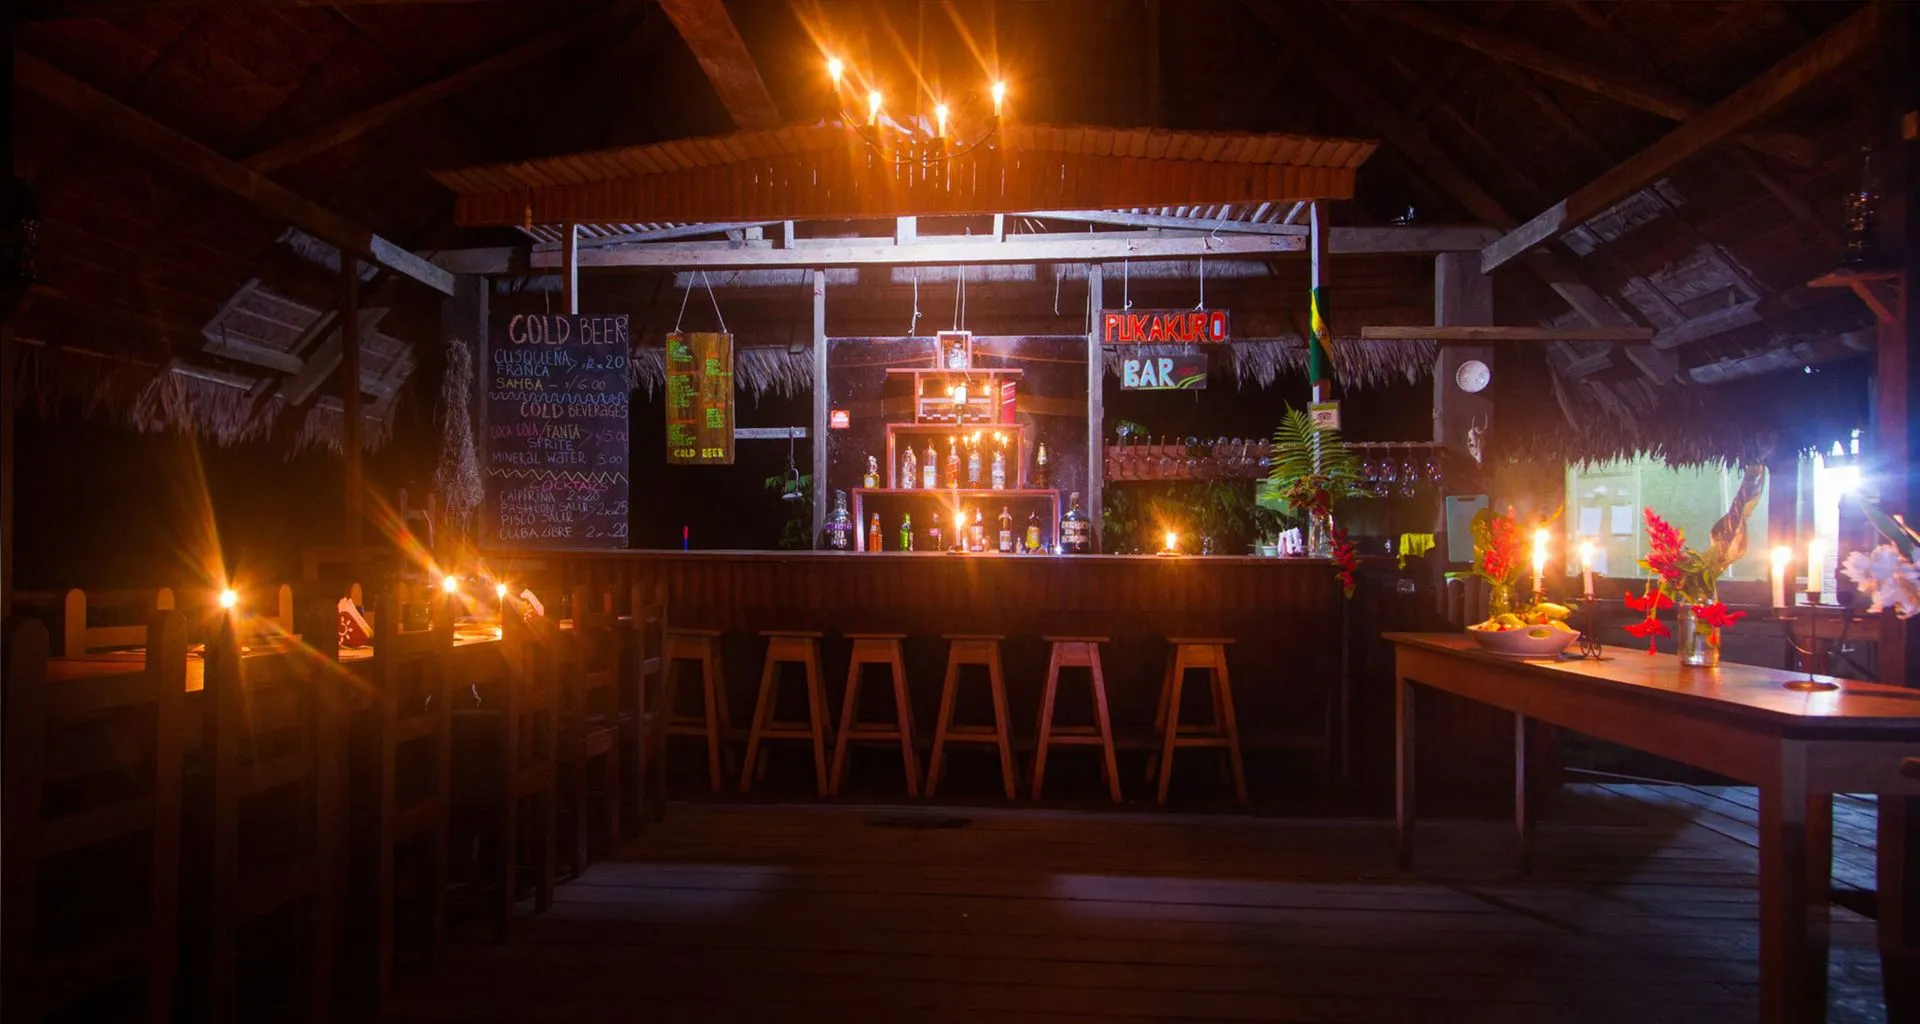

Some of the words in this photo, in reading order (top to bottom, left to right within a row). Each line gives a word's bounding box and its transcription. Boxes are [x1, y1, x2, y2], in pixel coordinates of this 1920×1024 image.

[509, 314, 570, 344] COLD
[580, 317, 627, 344] BEER
[1105, 311, 1226, 343] PUKAKURO
[606, 355, 624, 369] 20
[1124, 358, 1175, 387] BAR
[496, 377, 543, 391] SAMBA
[520, 402, 563, 418] COLD
[702, 448, 724, 458] BEER
